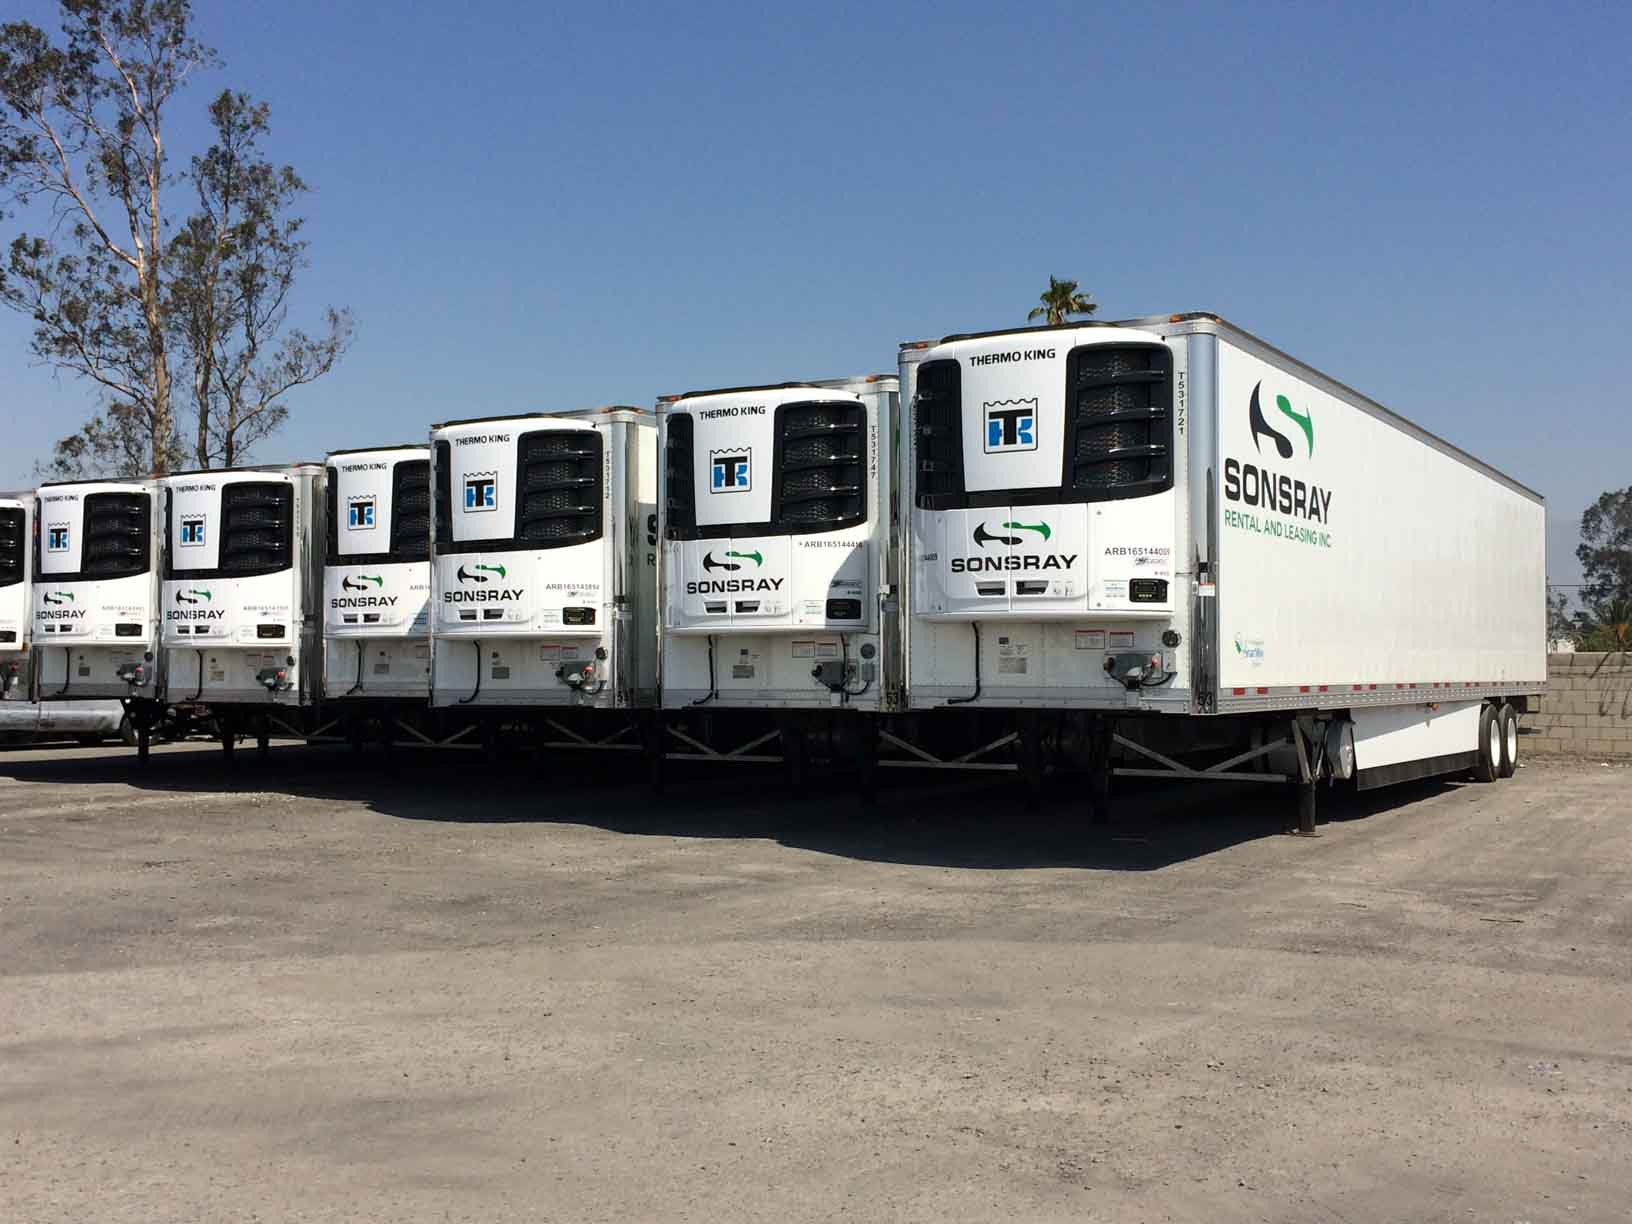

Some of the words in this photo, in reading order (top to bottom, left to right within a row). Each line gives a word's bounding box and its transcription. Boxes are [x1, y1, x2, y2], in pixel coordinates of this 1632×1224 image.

[969, 351, 1021, 367] THERMO
[1024, 348, 1056, 361] KING
[1177, 371, 1185, 435] T531721
[699, 407, 739, 421] THERMO
[740, 405, 766, 416] KING
[455, 434, 488, 447] THERMO
[488, 433, 511, 444] KING
[341, 463, 369, 473] THERMO
[369, 462, 388, 471] KING
[1224, 457, 1332, 525] SONSRAY
[1224, 509, 1262, 534] RENTAL
[1263, 519, 1283, 538] AND
[1284, 524, 1318, 546] LEASING
[1318, 529, 1332, 548] INC
[951, 554, 1078, 573] SONSRAY
[687, 578, 784, 594] SONSRAY
[331, 596, 398, 609] SONSRAY
[444, 588, 524, 603] SONSRAY
[35, 609, 87, 620] SONSRAY
[167, 609, 225, 620] SONSRAY
